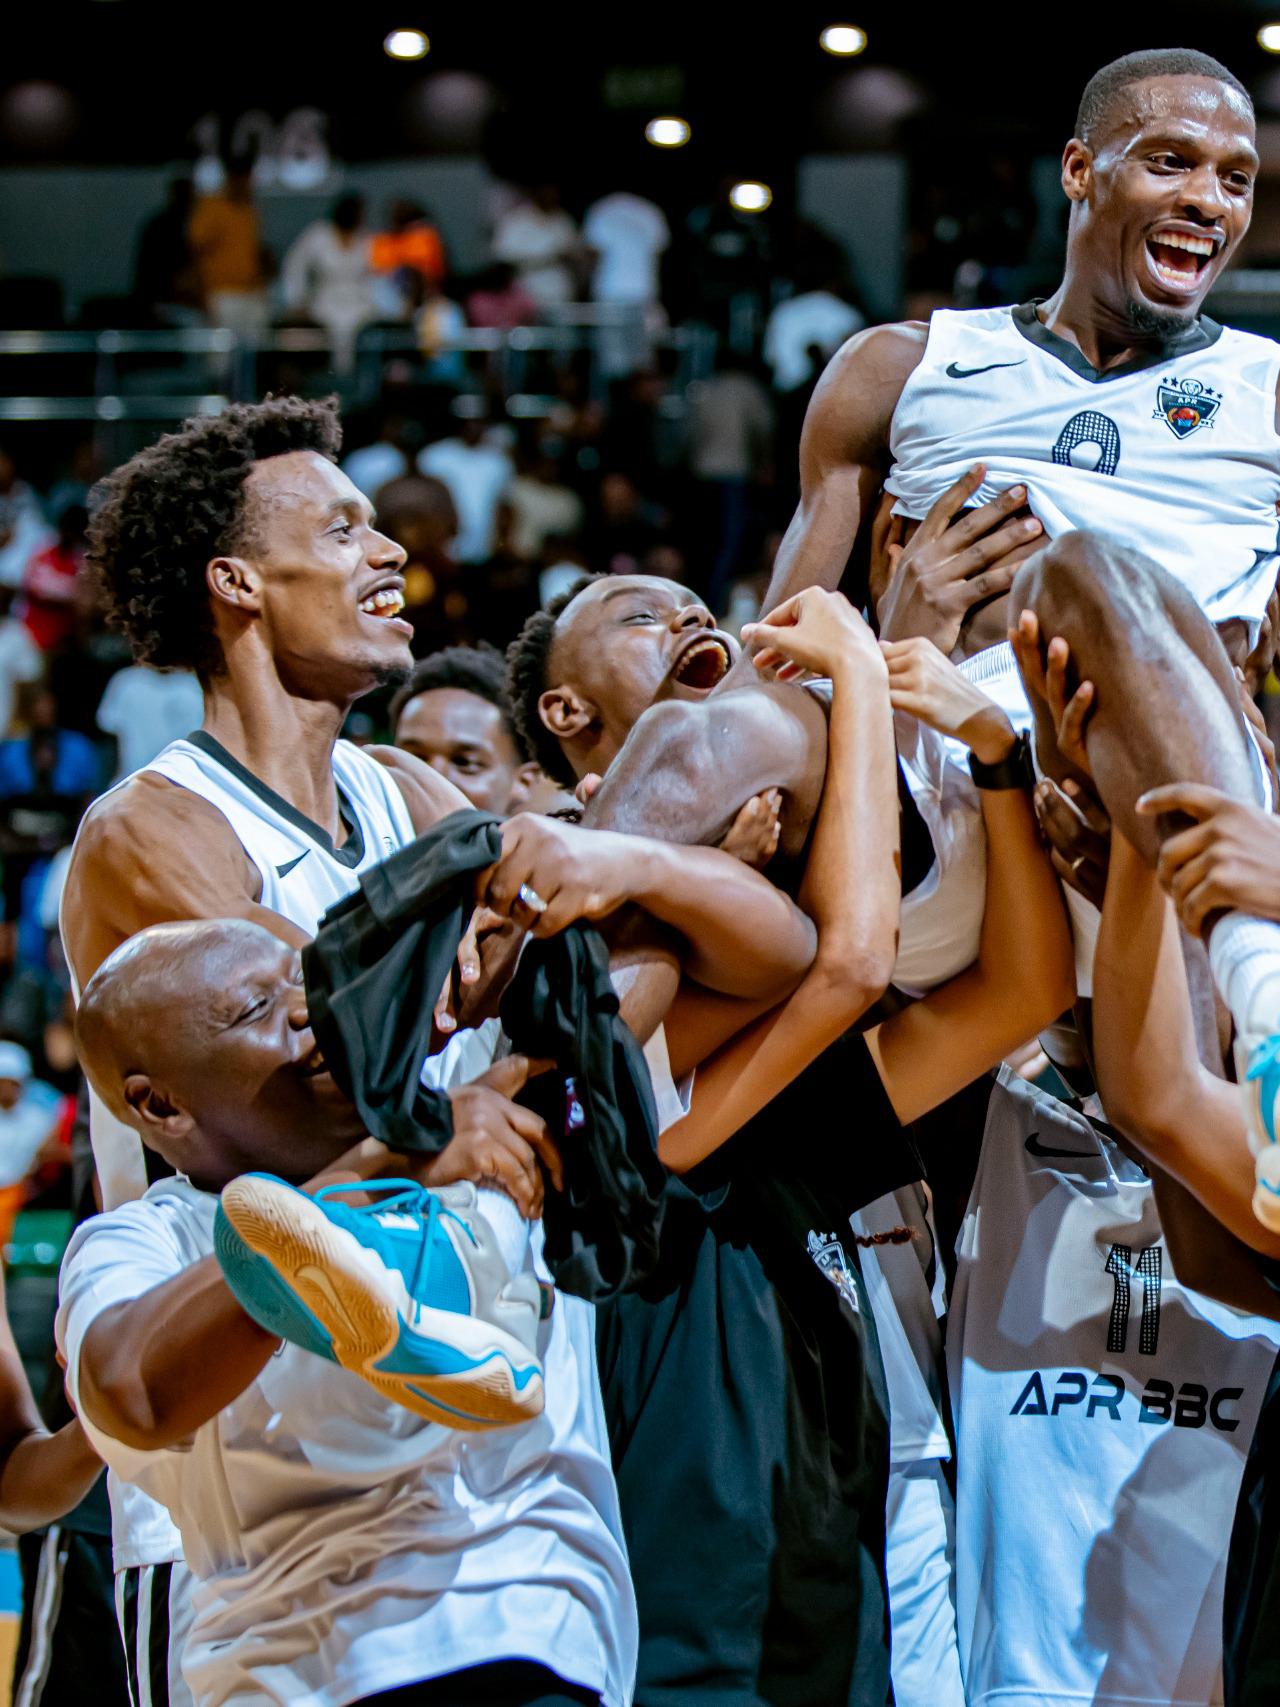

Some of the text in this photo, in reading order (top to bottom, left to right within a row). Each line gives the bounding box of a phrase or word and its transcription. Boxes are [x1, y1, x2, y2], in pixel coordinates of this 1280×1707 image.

[1105, 1243, 1162, 1355] 11
[1009, 1370, 1244, 1432] APR BBC
